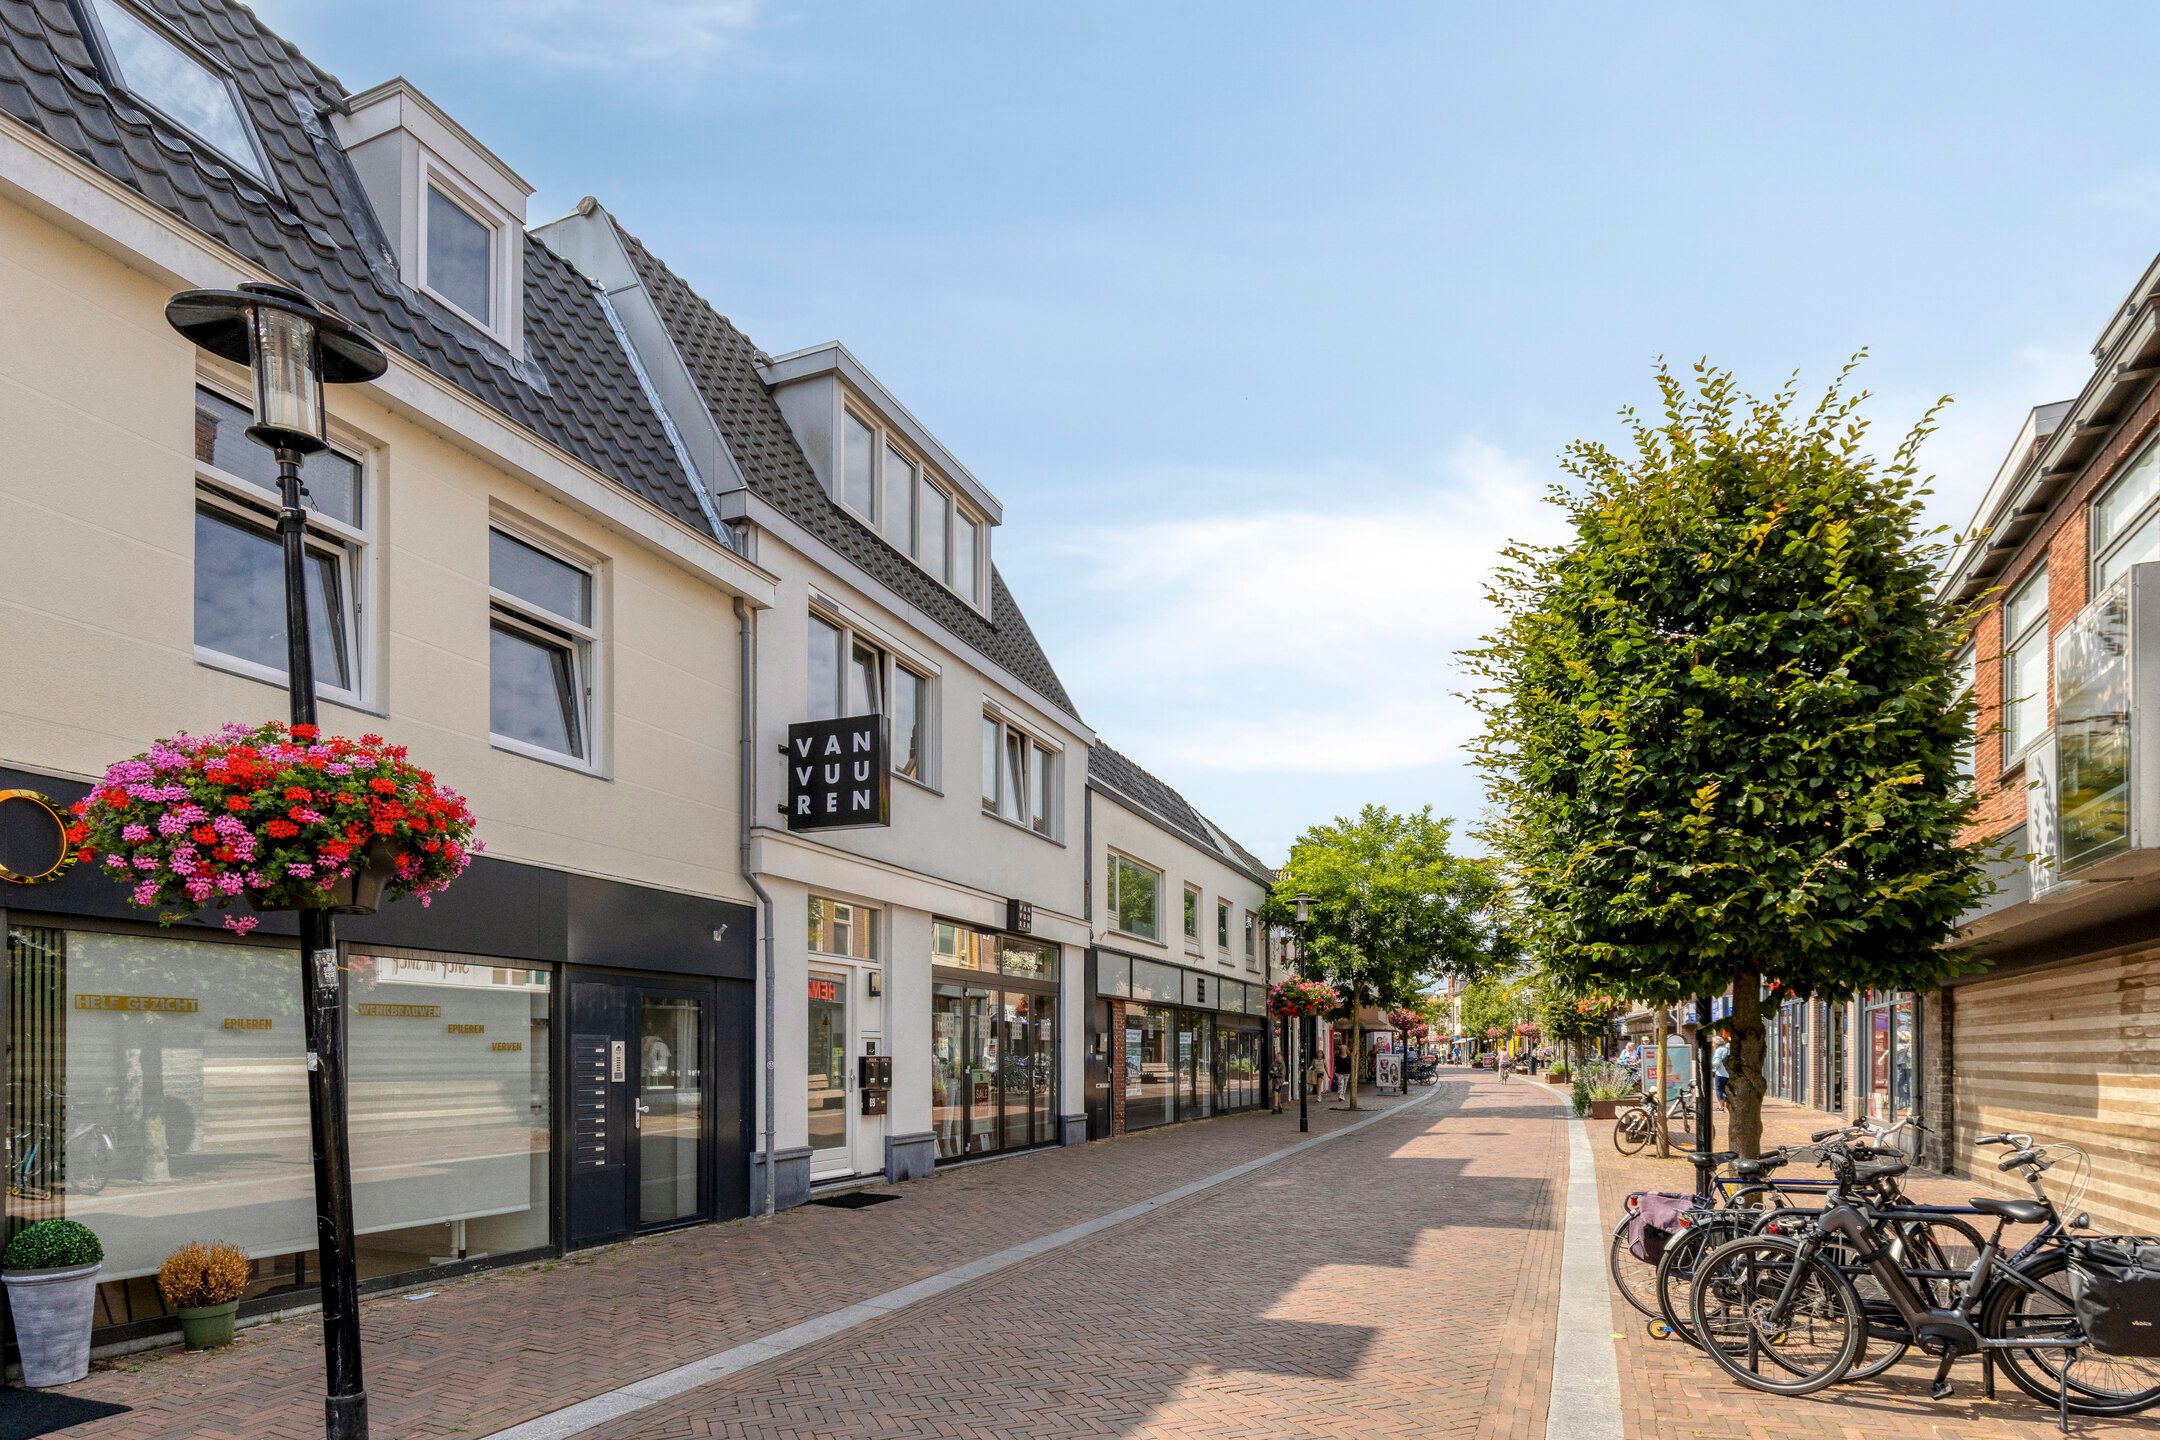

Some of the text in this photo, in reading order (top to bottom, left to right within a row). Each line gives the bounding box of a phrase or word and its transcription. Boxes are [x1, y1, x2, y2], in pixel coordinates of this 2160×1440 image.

[796, 731, 871, 758] VAN
[796, 761, 870, 786] VUU
[797, 789, 871, 815] REN
[77, 995, 198, 1012] HELE GEZICHT
[359, 1004, 441, 1017] WENKBRAUWEN
[223, 1018, 273, 1030] EPILEREN
[447, 1024, 485, 1034] EPILEREN
[491, 1042, 522, 1052] VERVEN
[975, 1089, 989, 1099] SALE
